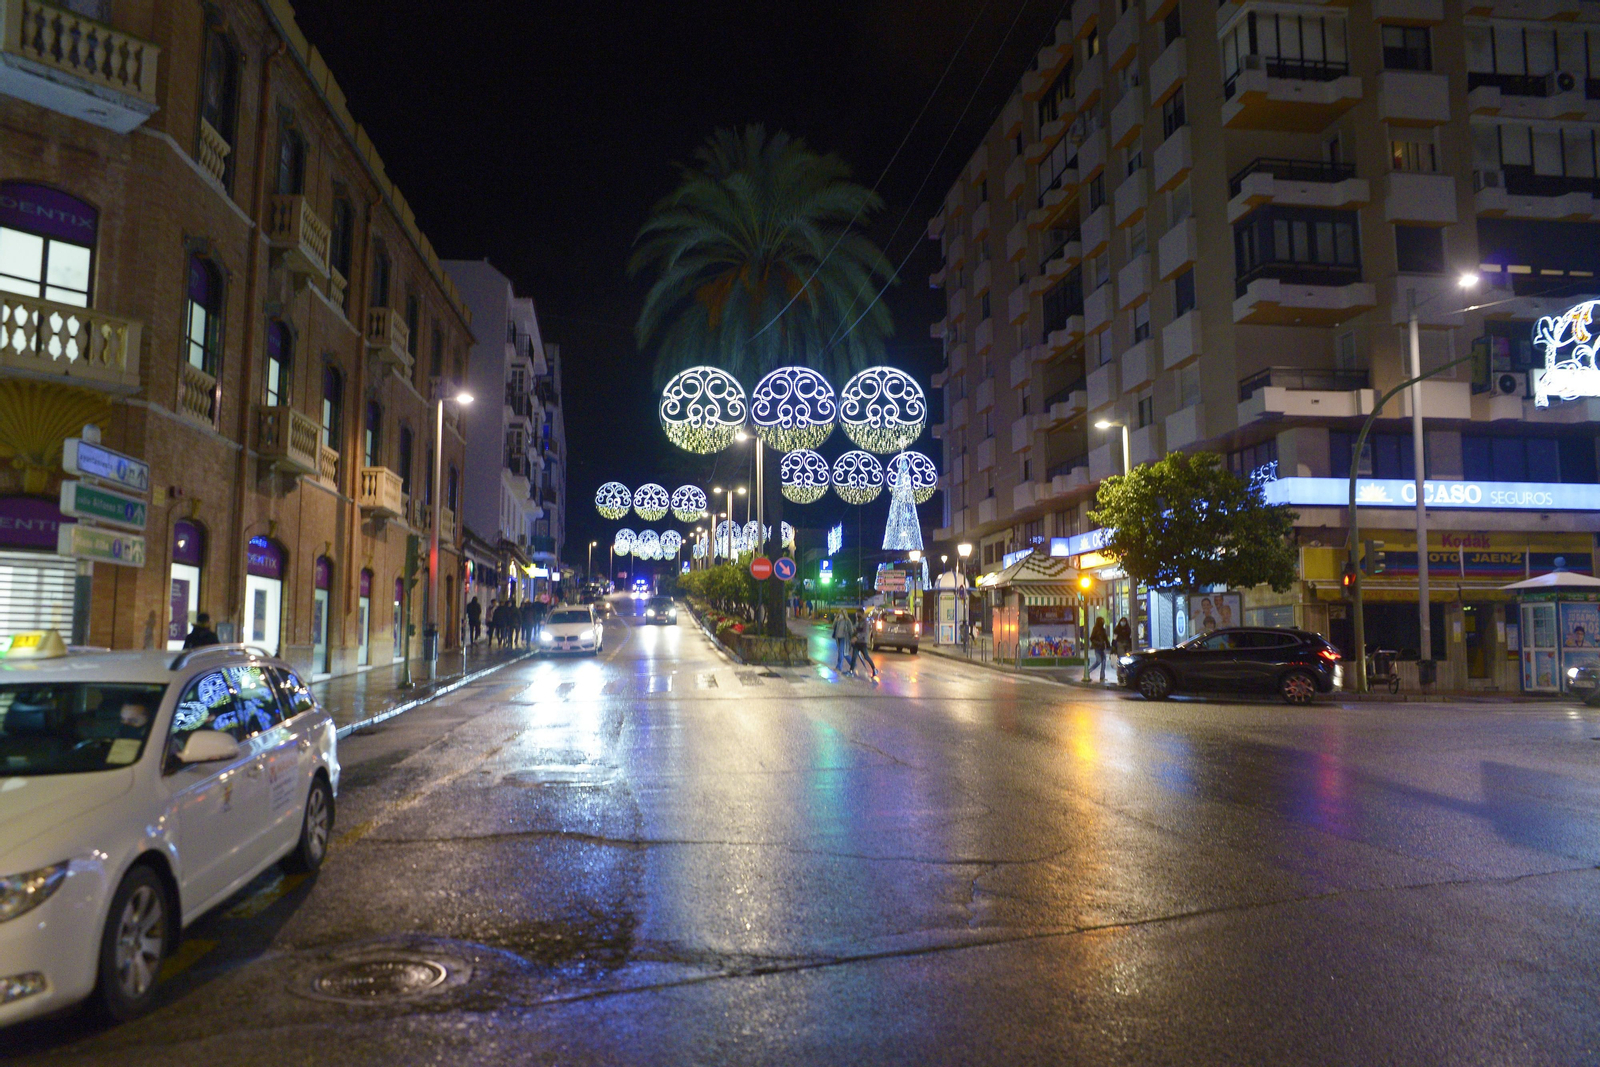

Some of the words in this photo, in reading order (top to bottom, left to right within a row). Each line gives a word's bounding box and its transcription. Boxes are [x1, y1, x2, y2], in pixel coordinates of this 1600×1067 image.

[1401, 483, 1482, 504] OCASO
[1490, 490, 1553, 506] SEGUROS
[1441, 533, 1491, 548] Kodak
[1427, 552, 1460, 563] OTO
[1471, 552, 1522, 564] JAEN2
